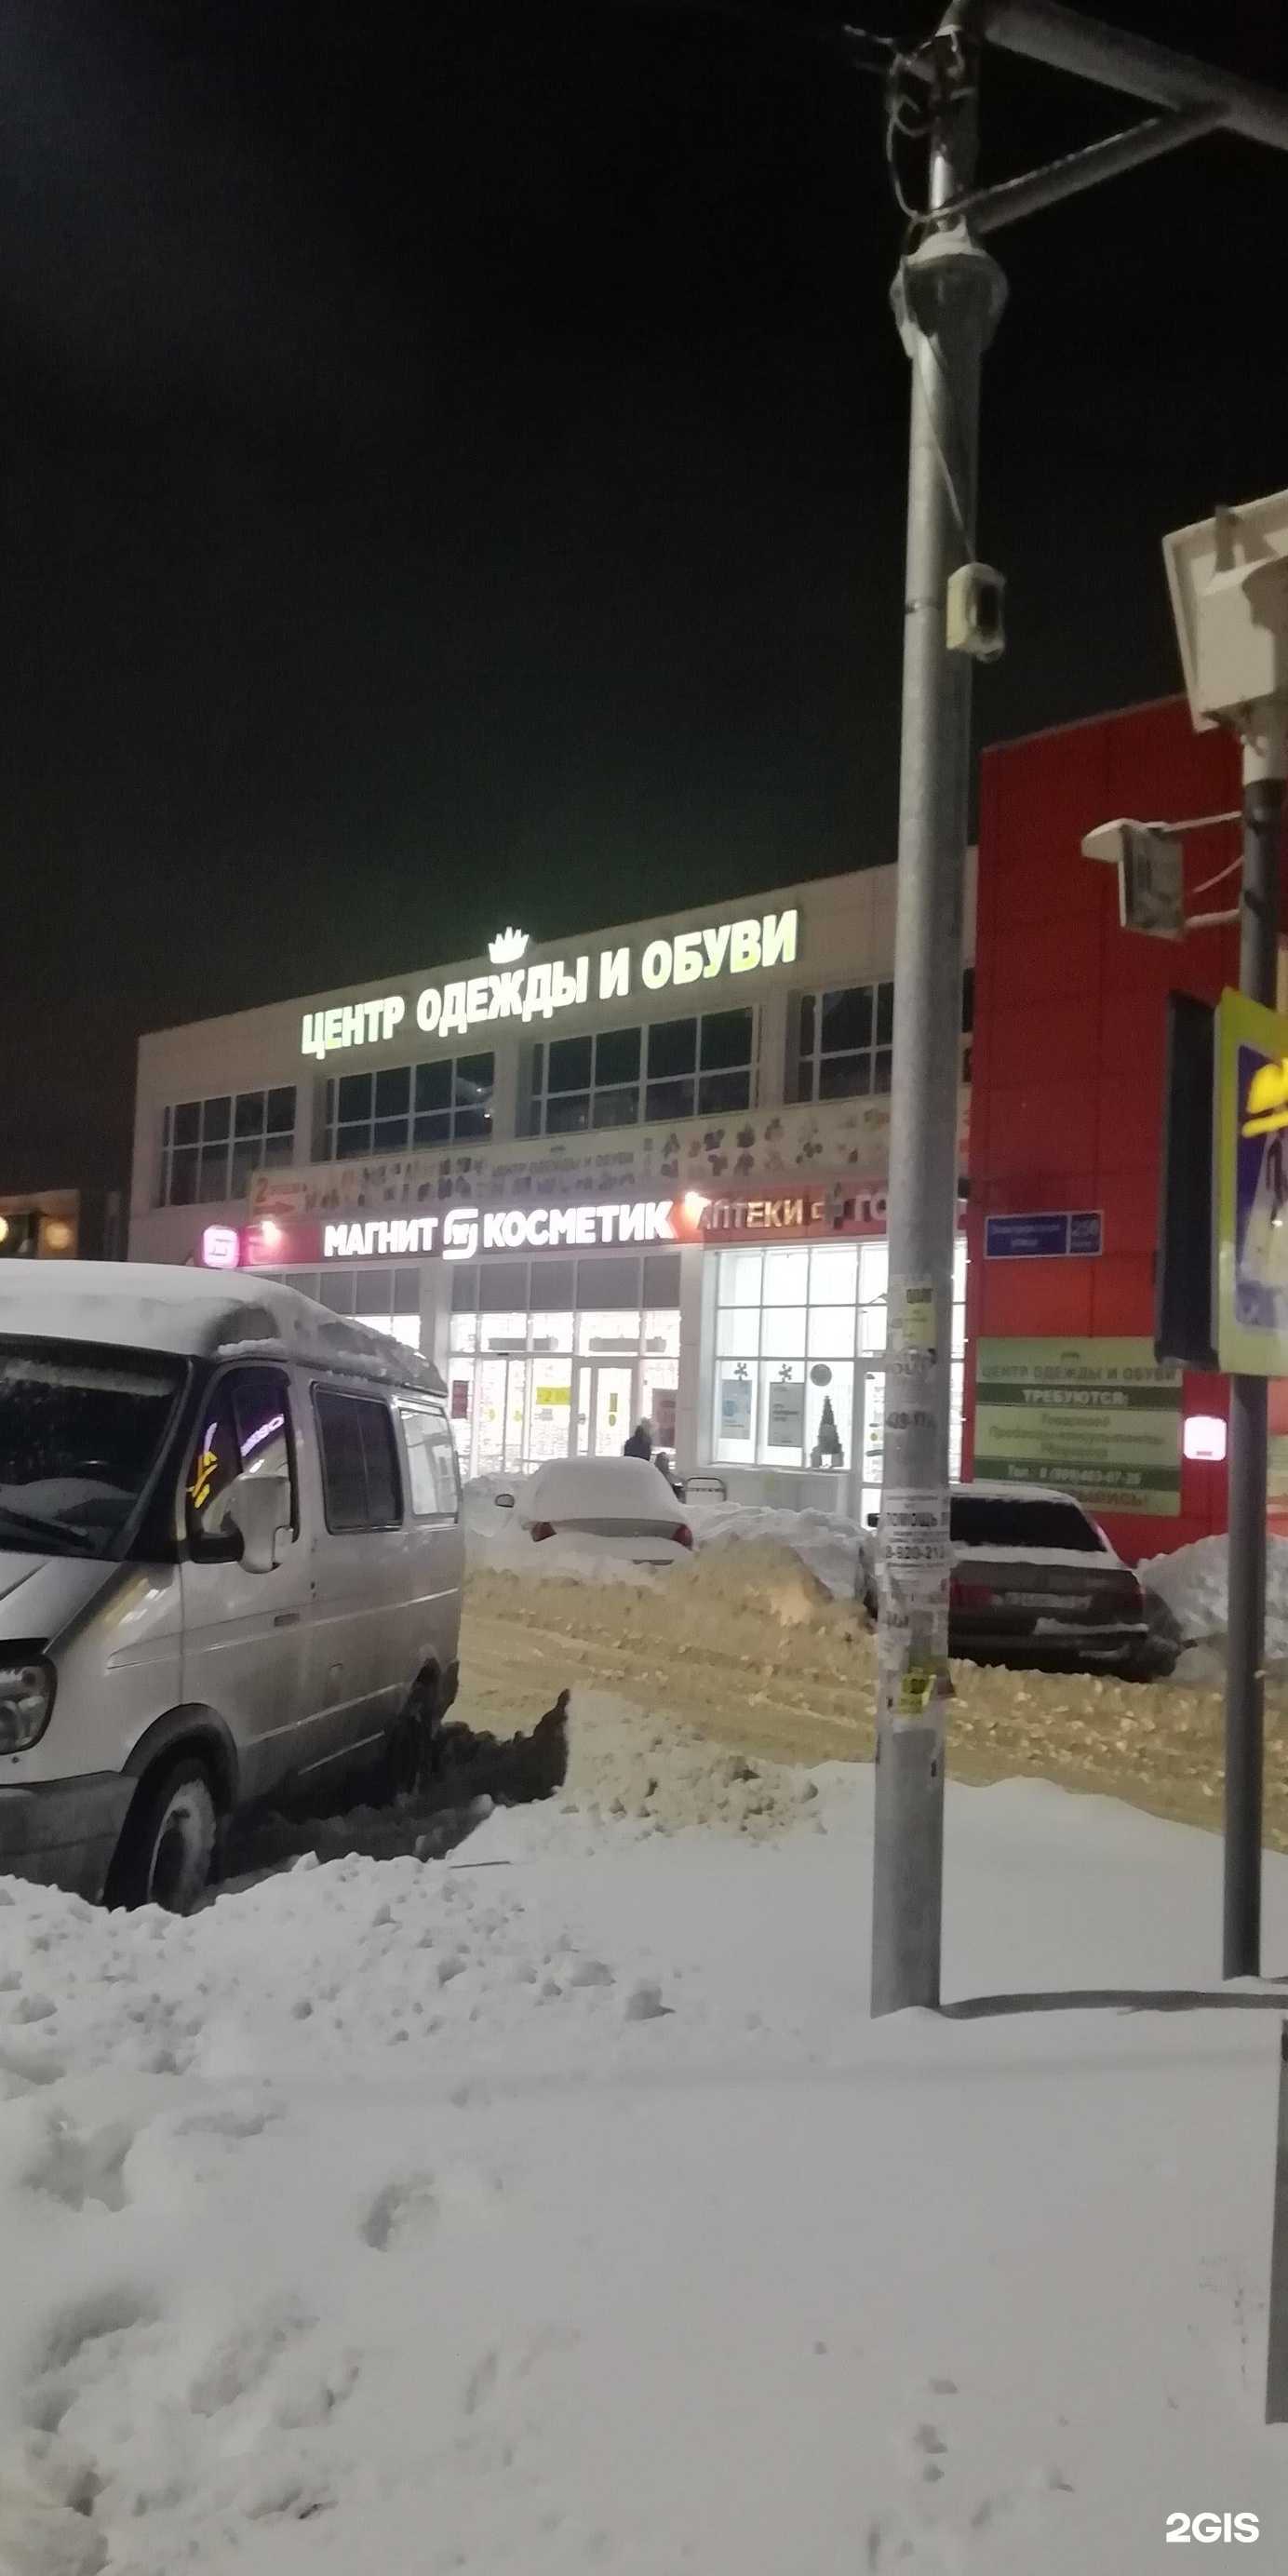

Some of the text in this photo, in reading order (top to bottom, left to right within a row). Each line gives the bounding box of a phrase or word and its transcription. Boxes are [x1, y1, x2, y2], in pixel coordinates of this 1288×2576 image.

[301, 909, 798, 1060] ЦЕНТР ОДЕЖДЫ И ОБУВИ
[323, 1201, 679, 1257] МАГНИТ КОСМЕТИК
